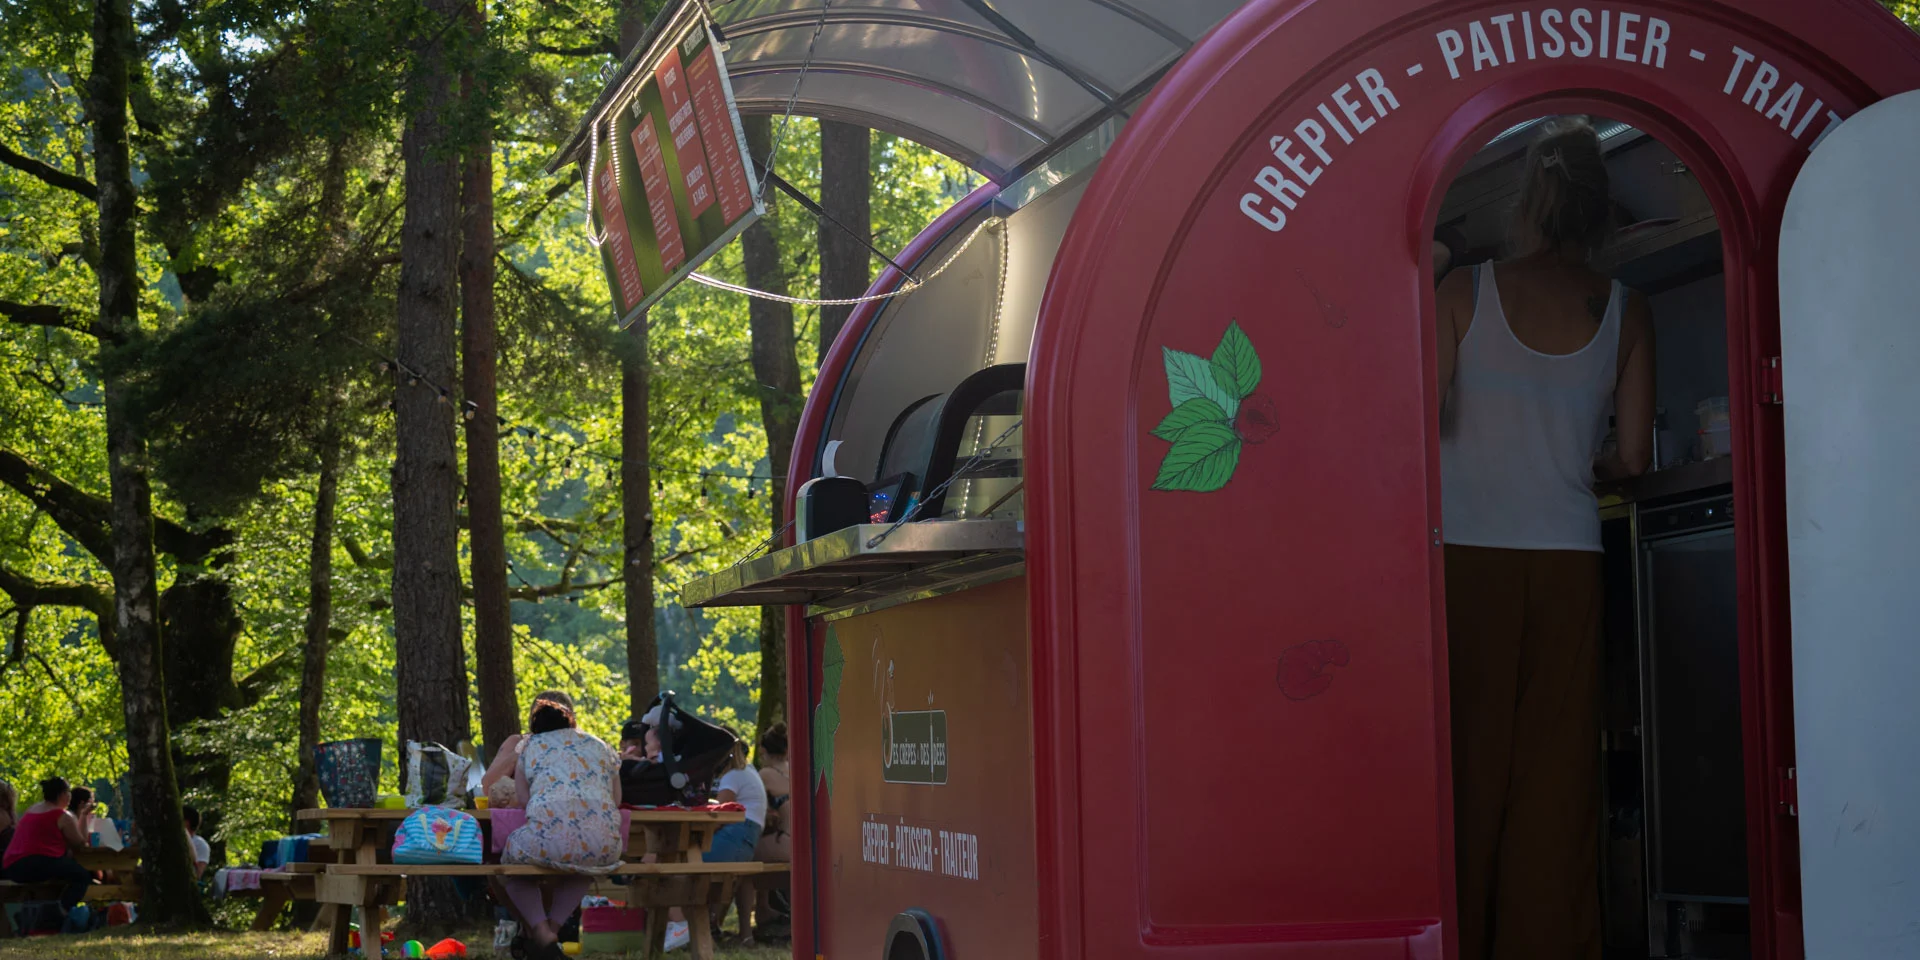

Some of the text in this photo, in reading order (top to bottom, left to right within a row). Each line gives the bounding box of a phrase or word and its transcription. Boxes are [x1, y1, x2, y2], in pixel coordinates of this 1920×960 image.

[1239, 67, 1401, 232] CRÊPIER
[1436, 8, 1671, 80] PATISSIER
[899, 738, 917, 765] CRÊPES
[920, 743, 930, 765] DES
[862, 813, 889, 865] CRÊPIER
[895, 816, 933, 873] PÂTISSIER
[939, 830, 979, 881] TRAITEUR
